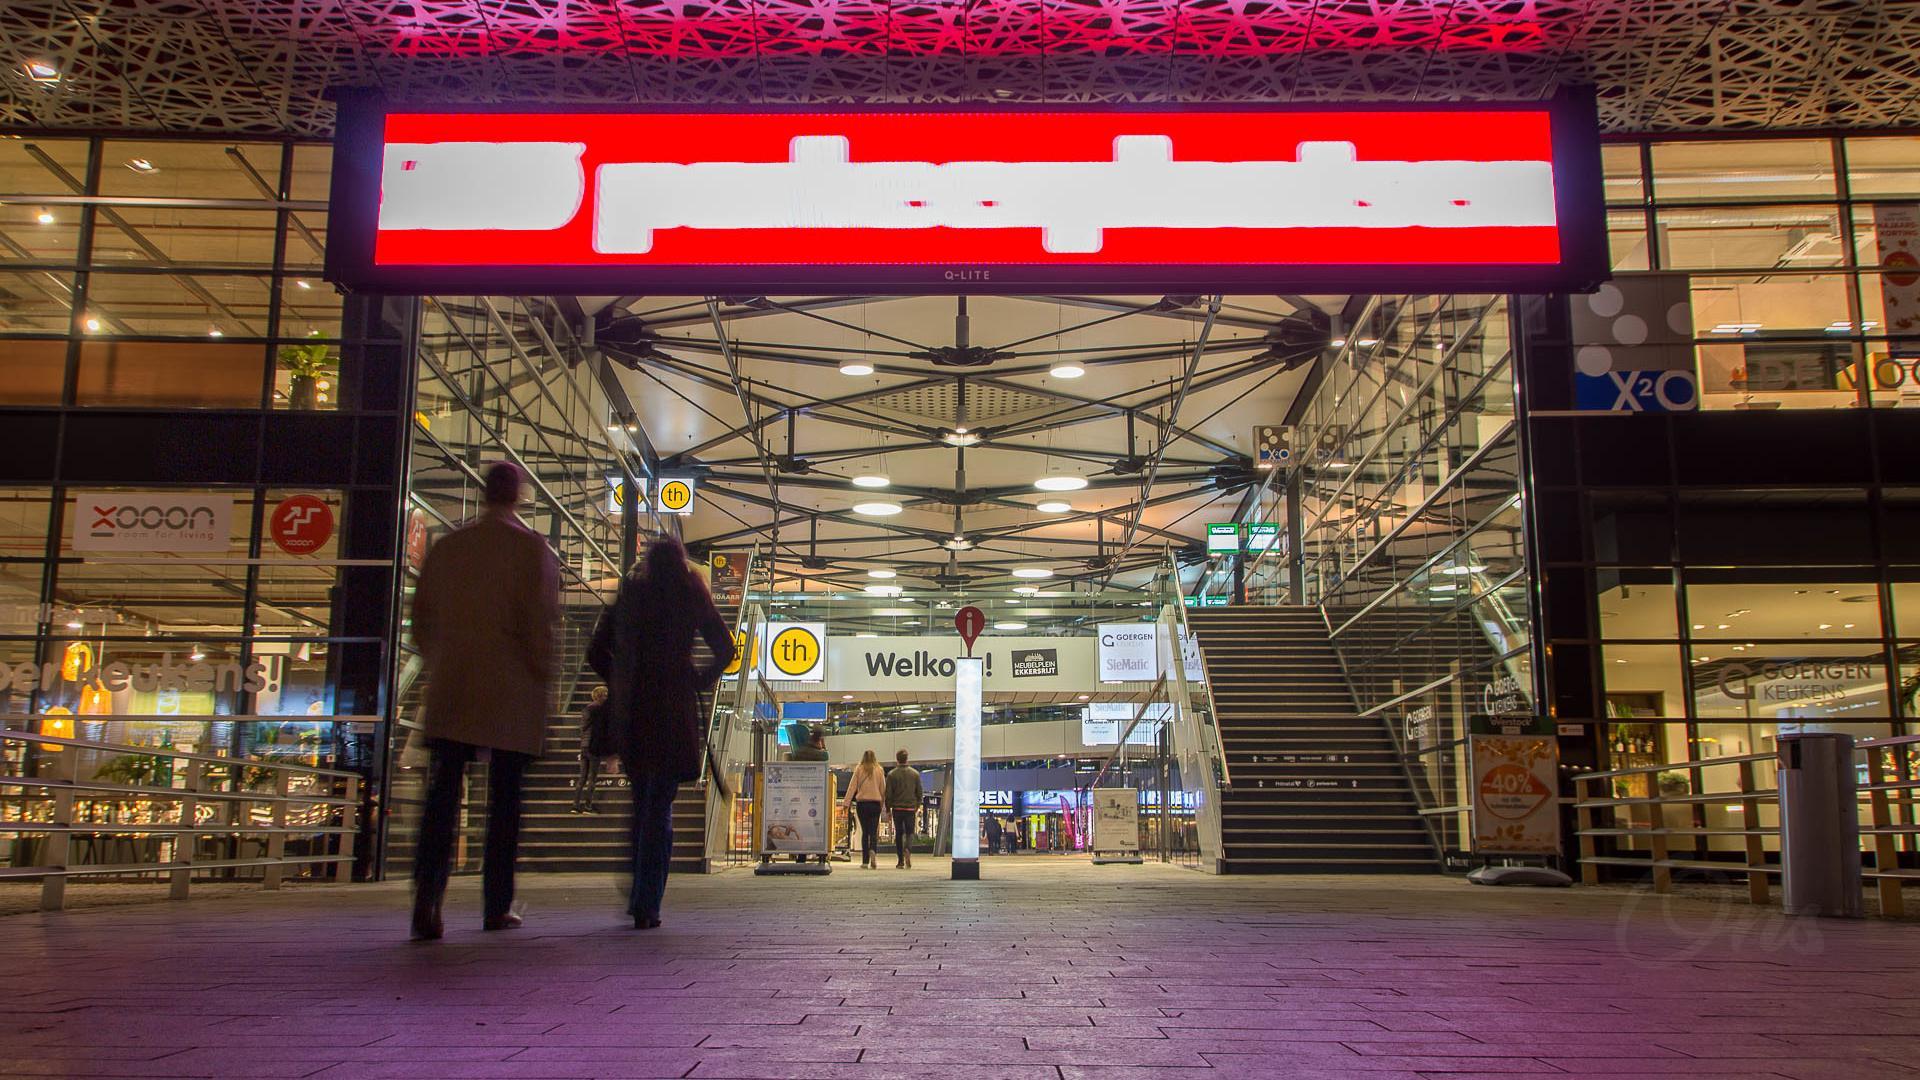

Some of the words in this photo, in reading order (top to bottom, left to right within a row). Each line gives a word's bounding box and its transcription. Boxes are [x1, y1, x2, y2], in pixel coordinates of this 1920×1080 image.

[944, 270, 990, 280] Q-LITE
[91, 505, 215, 530] xooon
[154, 531, 174, 539] for
[179, 530, 214, 542] living
[1116, 633, 1153, 641] GOERGEN
[781, 638, 807, 662] th
[865, 651, 993, 677] Welko!
[1014, 661, 1056, 669] MEUBELPLEIN
[1763, 663, 1871, 680] GOERGEN
[1763, 685, 1846, 700] KEUKENS
[1483, 770, 1533, 794] -40%
